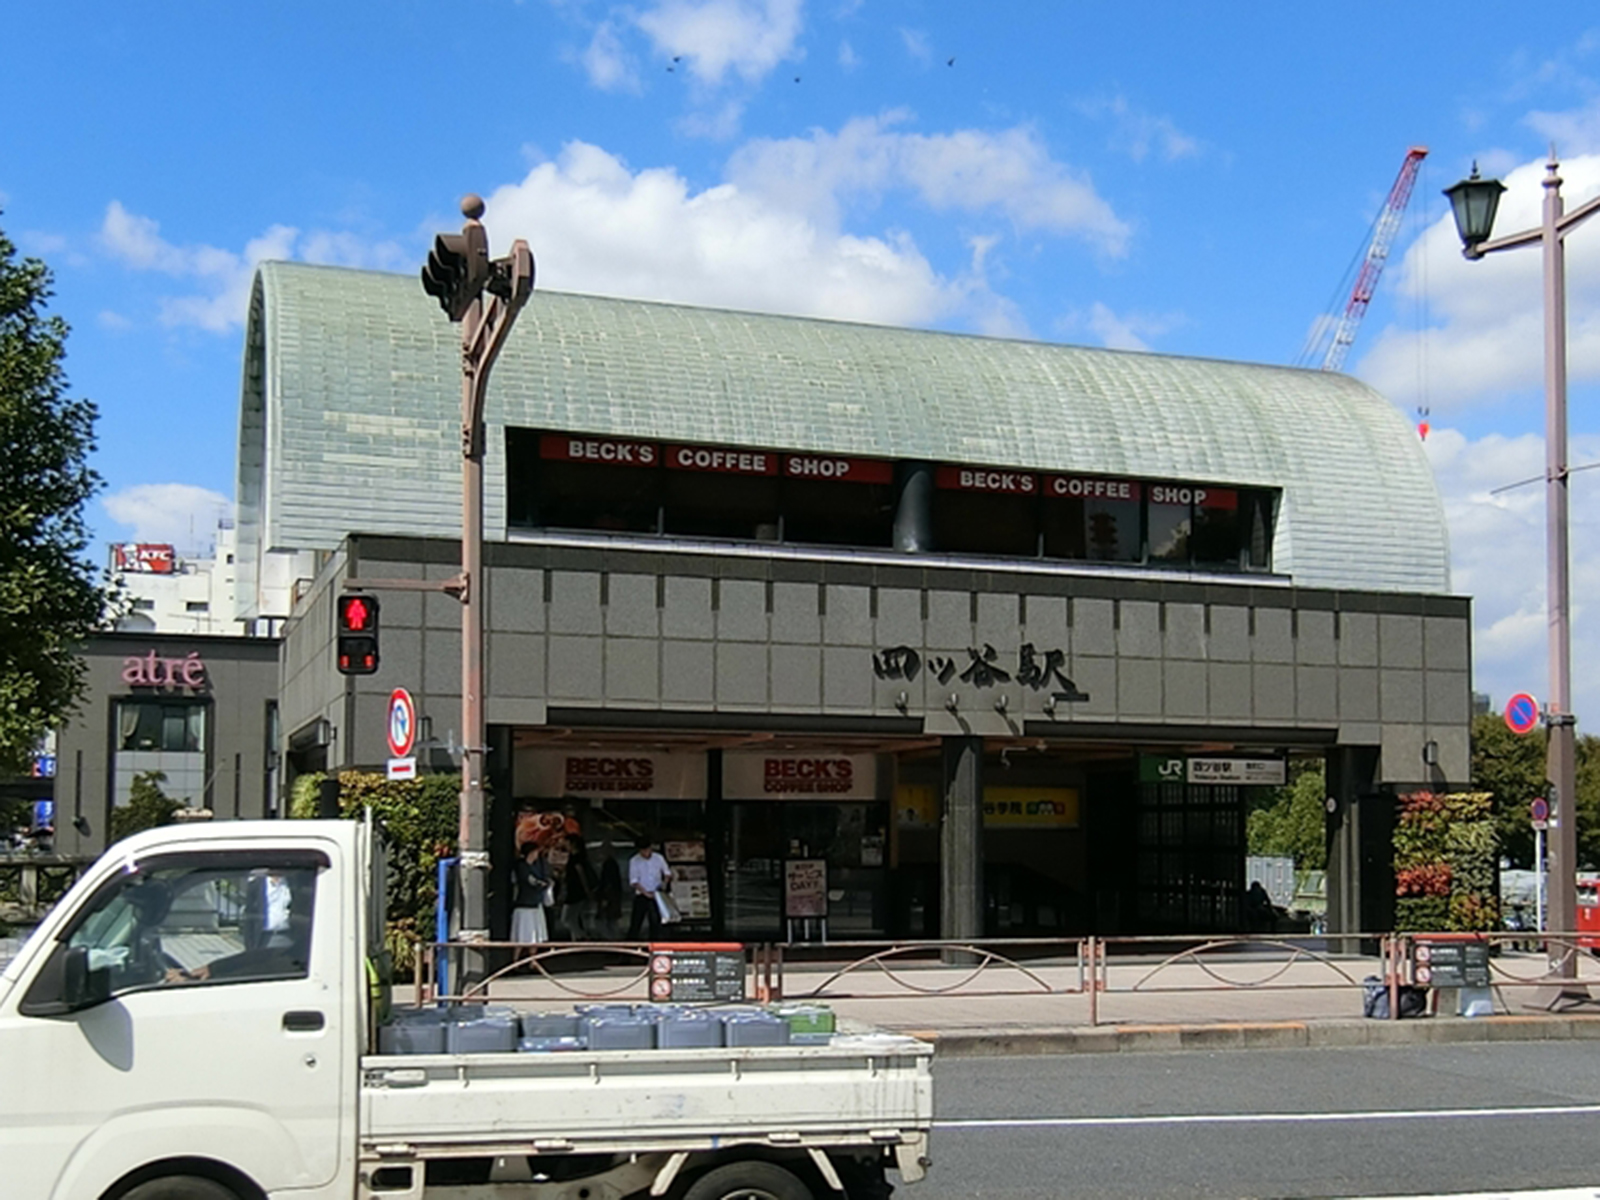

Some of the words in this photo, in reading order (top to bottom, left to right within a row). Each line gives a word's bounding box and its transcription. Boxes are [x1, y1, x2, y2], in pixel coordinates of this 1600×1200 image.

[569, 440, 653, 462] BECK'S
[678, 450, 766, 471] COFFEE
[789, 458, 850, 477] SHOP
[960, 470, 1034, 491] BECK'S
[1054, 478, 1131, 499] COFFEE
[1153, 485, 1207, 504] SHOP
[139, 549, 172, 561] KFC
[121, 649, 205, 687] atré
[872, 643, 1090, 702] 四ツ谷駅
[565, 757, 654, 777] BECK'S
[764, 759, 853, 777] BECK'S
[1157, 759, 1184, 775] JR
[565, 780, 615, 791] COFFEE
[617, 780, 654, 791] SHOP
[764, 781, 814, 793] COFFEE
[816, 781, 853, 793] SHOP
